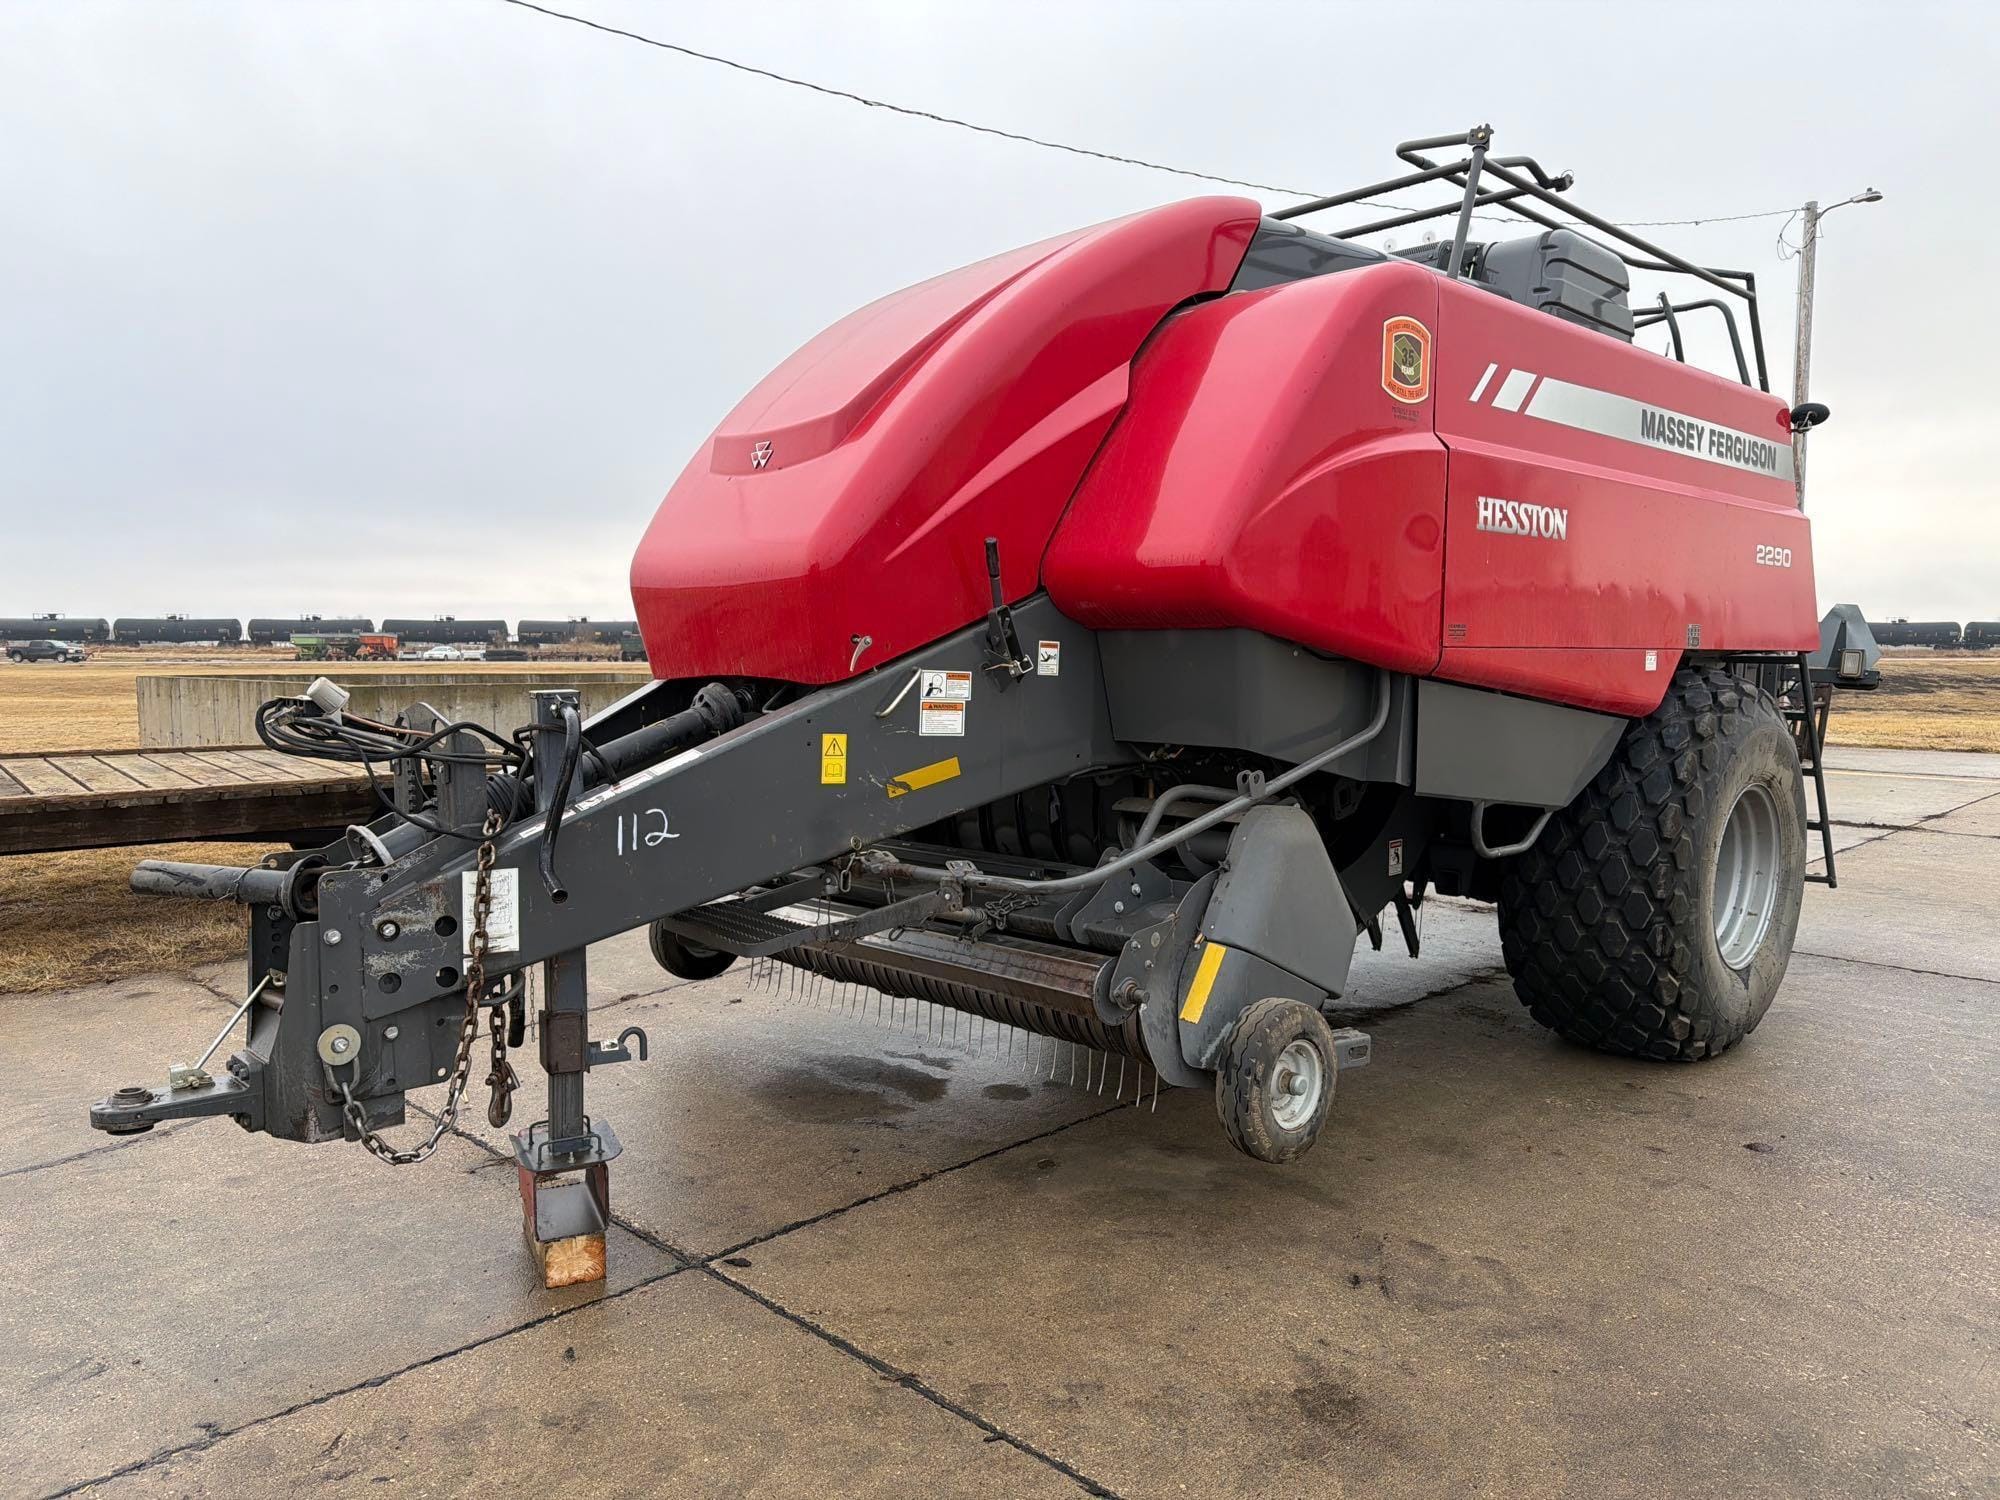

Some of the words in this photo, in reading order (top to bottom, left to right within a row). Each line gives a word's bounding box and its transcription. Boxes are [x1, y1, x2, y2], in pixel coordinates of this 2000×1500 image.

[1401, 347, 1415, 367] 35
[1401, 365, 1415, 376] YEARS
[1641, 408, 1705, 453] MASSEY
[1708, 428, 1777, 472] FERGUSON
[1476, 495, 1568, 541] HESSTON
[1755, 544, 1792, 568] 2290
[617, 808, 680, 856] 112
